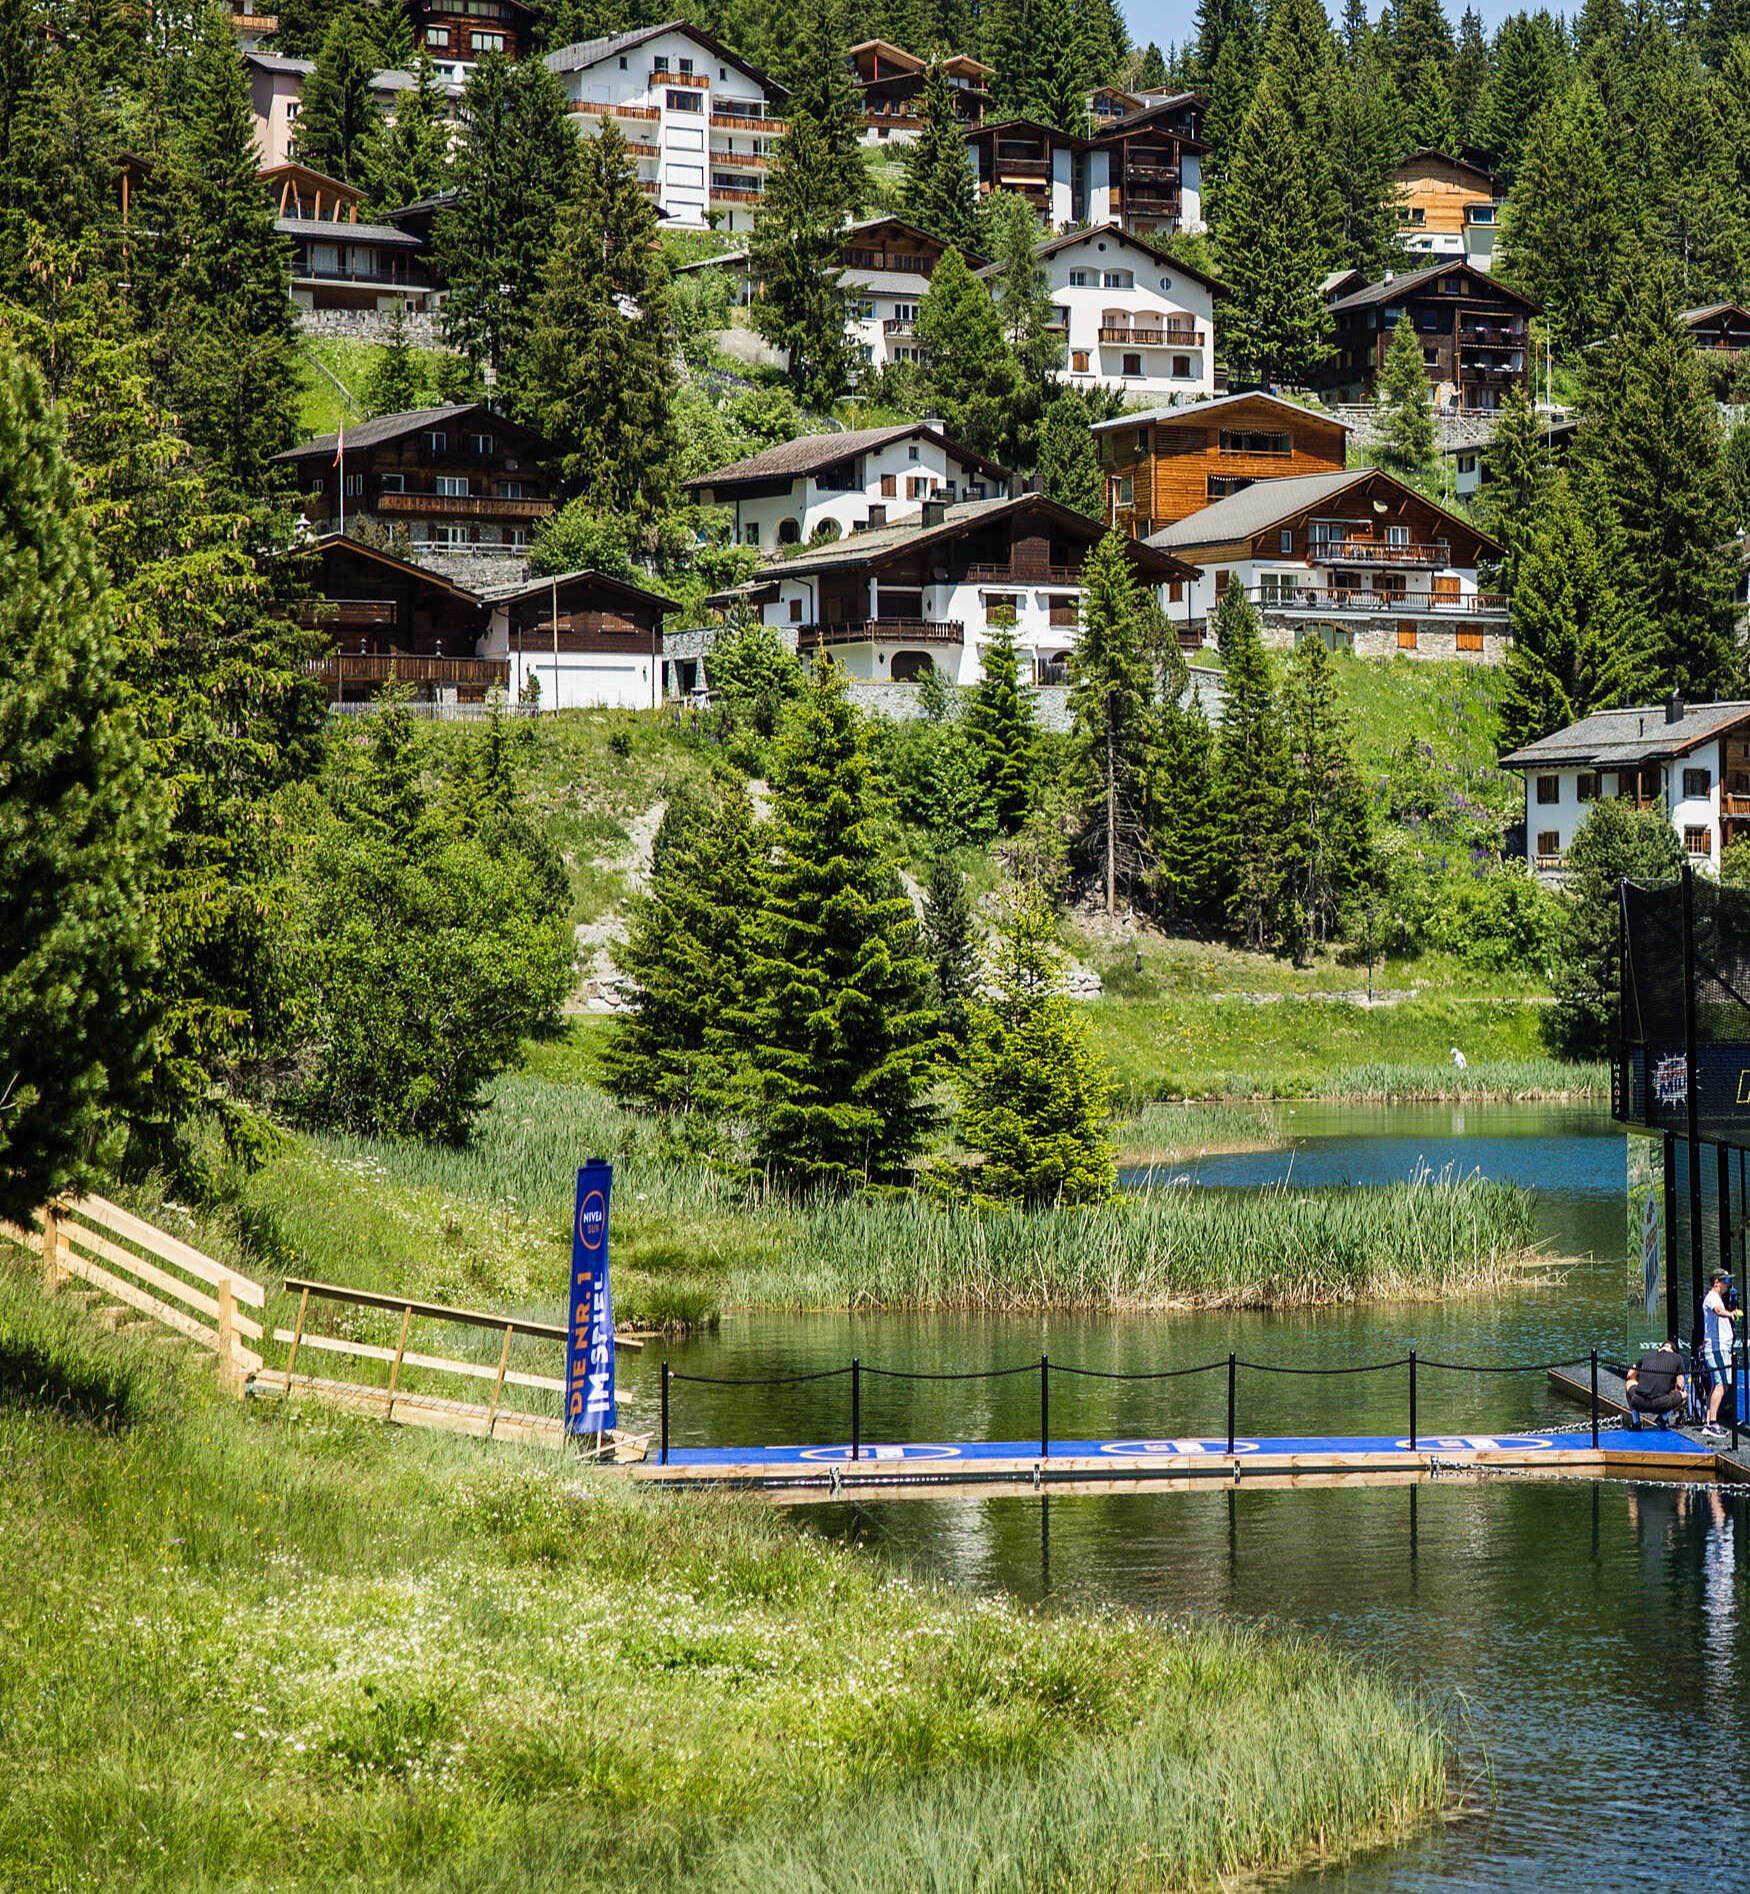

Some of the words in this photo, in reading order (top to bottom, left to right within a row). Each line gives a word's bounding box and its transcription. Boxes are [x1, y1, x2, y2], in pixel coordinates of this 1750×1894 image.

[583, 1211, 602, 1223] NIVEA
[591, 1271, 608, 1365] SPIEL
[570, 1358, 586, 1415] DIE
[587, 1372, 610, 1413] IM
